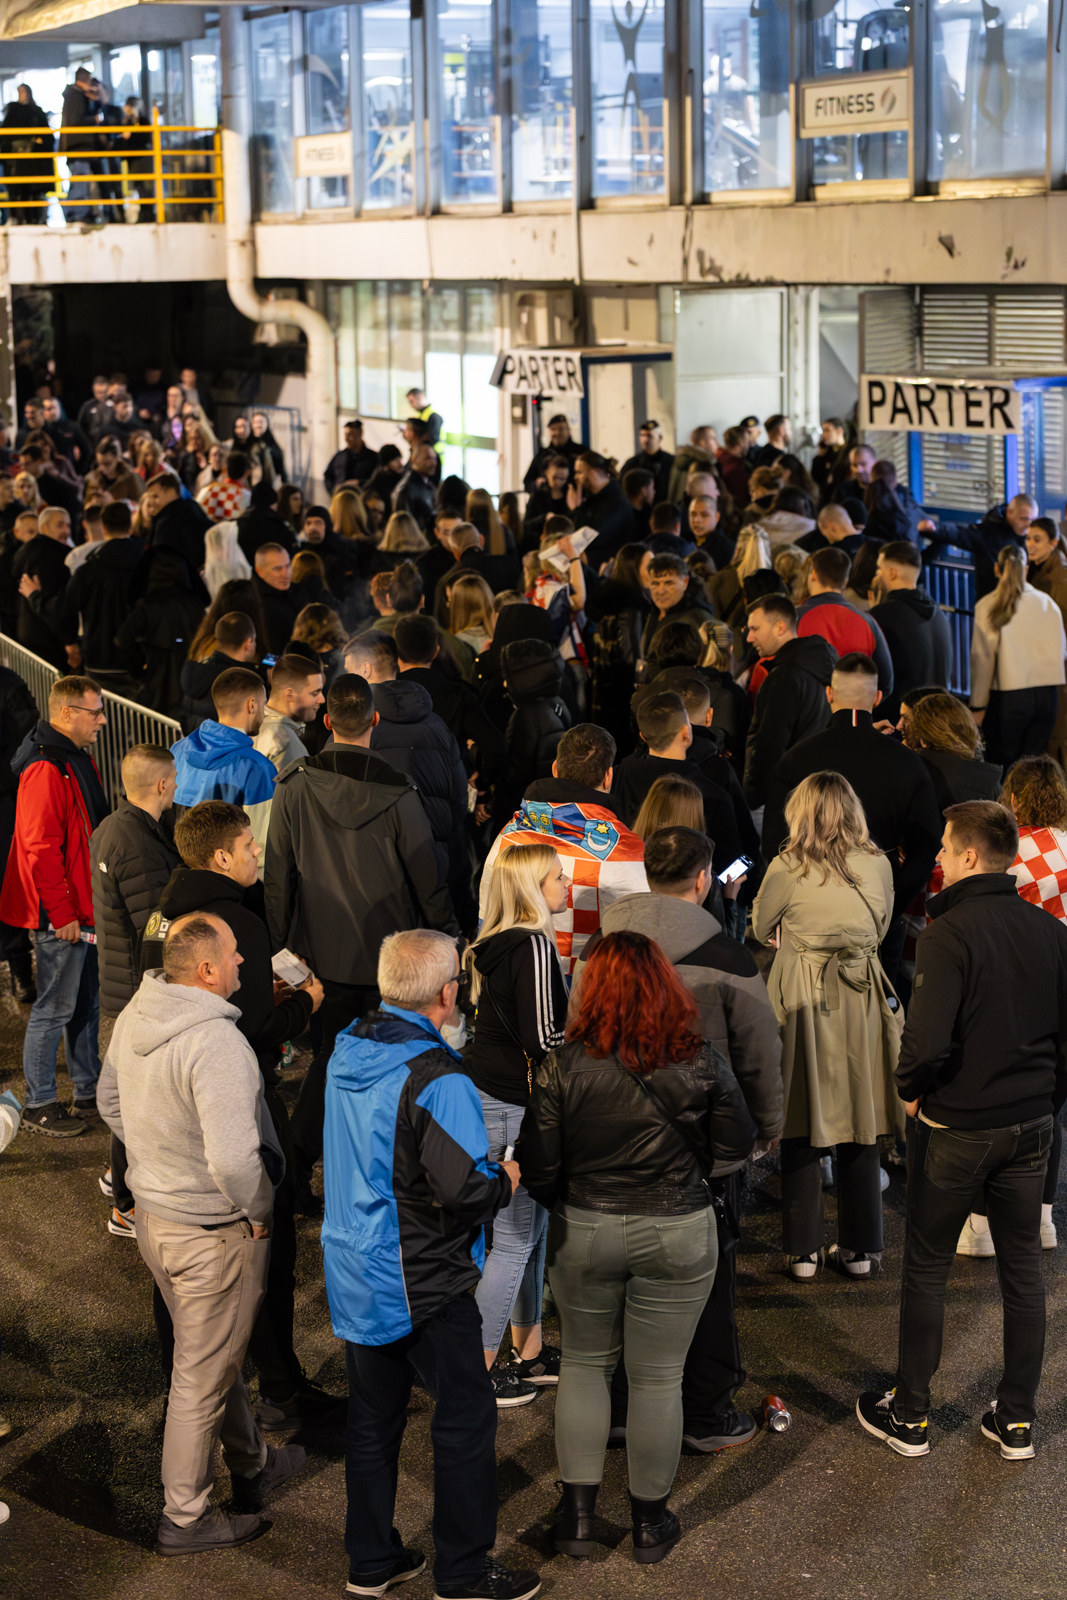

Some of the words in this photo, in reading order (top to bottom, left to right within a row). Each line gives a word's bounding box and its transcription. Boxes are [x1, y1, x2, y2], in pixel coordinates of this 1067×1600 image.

[815, 92, 875, 117] FITNESS
[497, 355, 583, 392] PARTER
[868, 380, 1015, 429] PARTER
